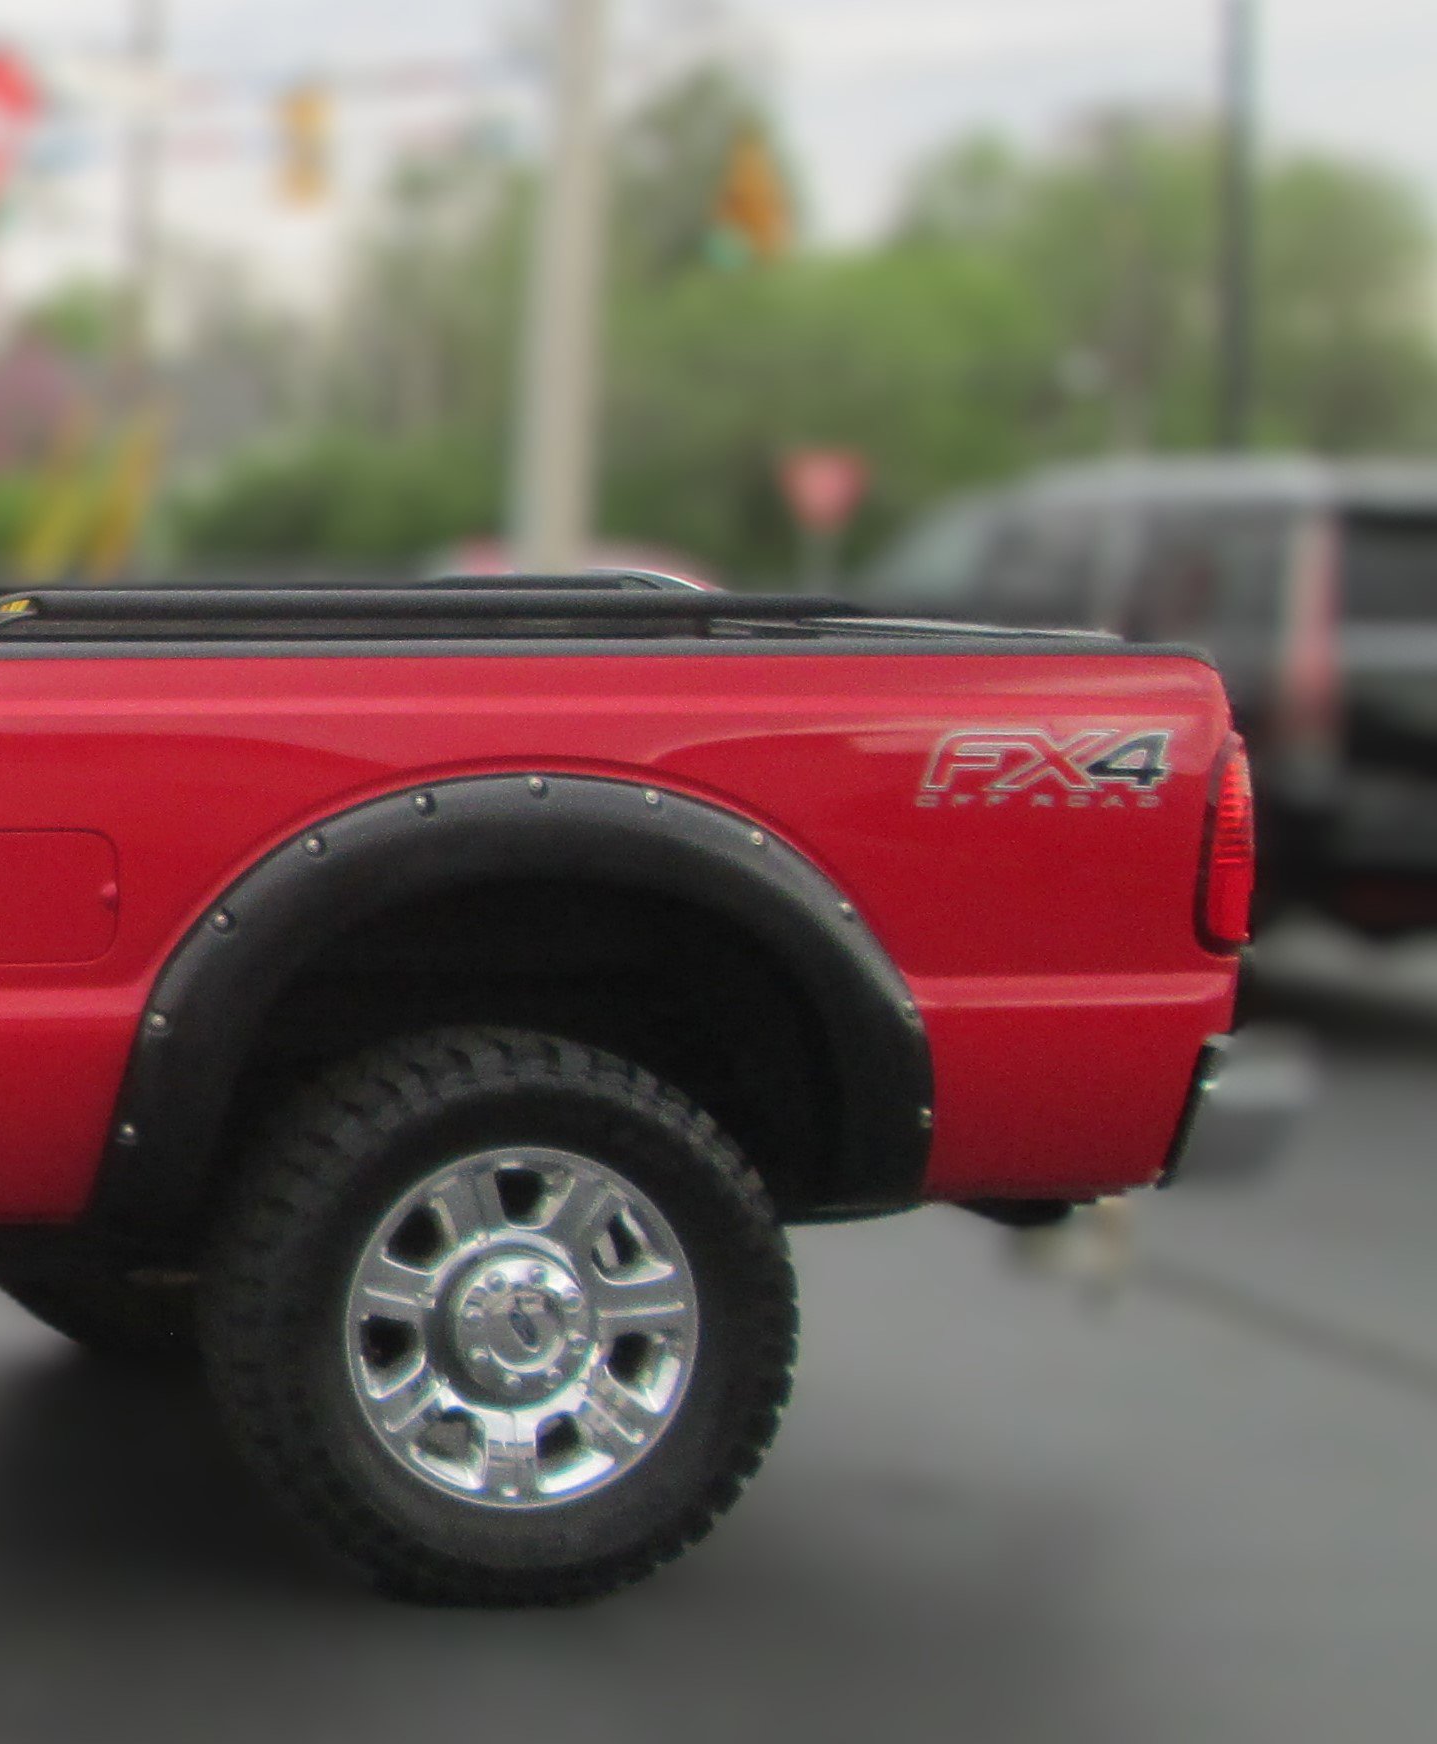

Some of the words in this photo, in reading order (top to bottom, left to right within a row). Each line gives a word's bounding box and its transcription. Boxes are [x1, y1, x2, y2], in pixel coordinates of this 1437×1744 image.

[922, 728, 1172, 791] FX4
[915, 794, 1010, 808] OFF
[1030, 794, 1162, 808] ROAD
